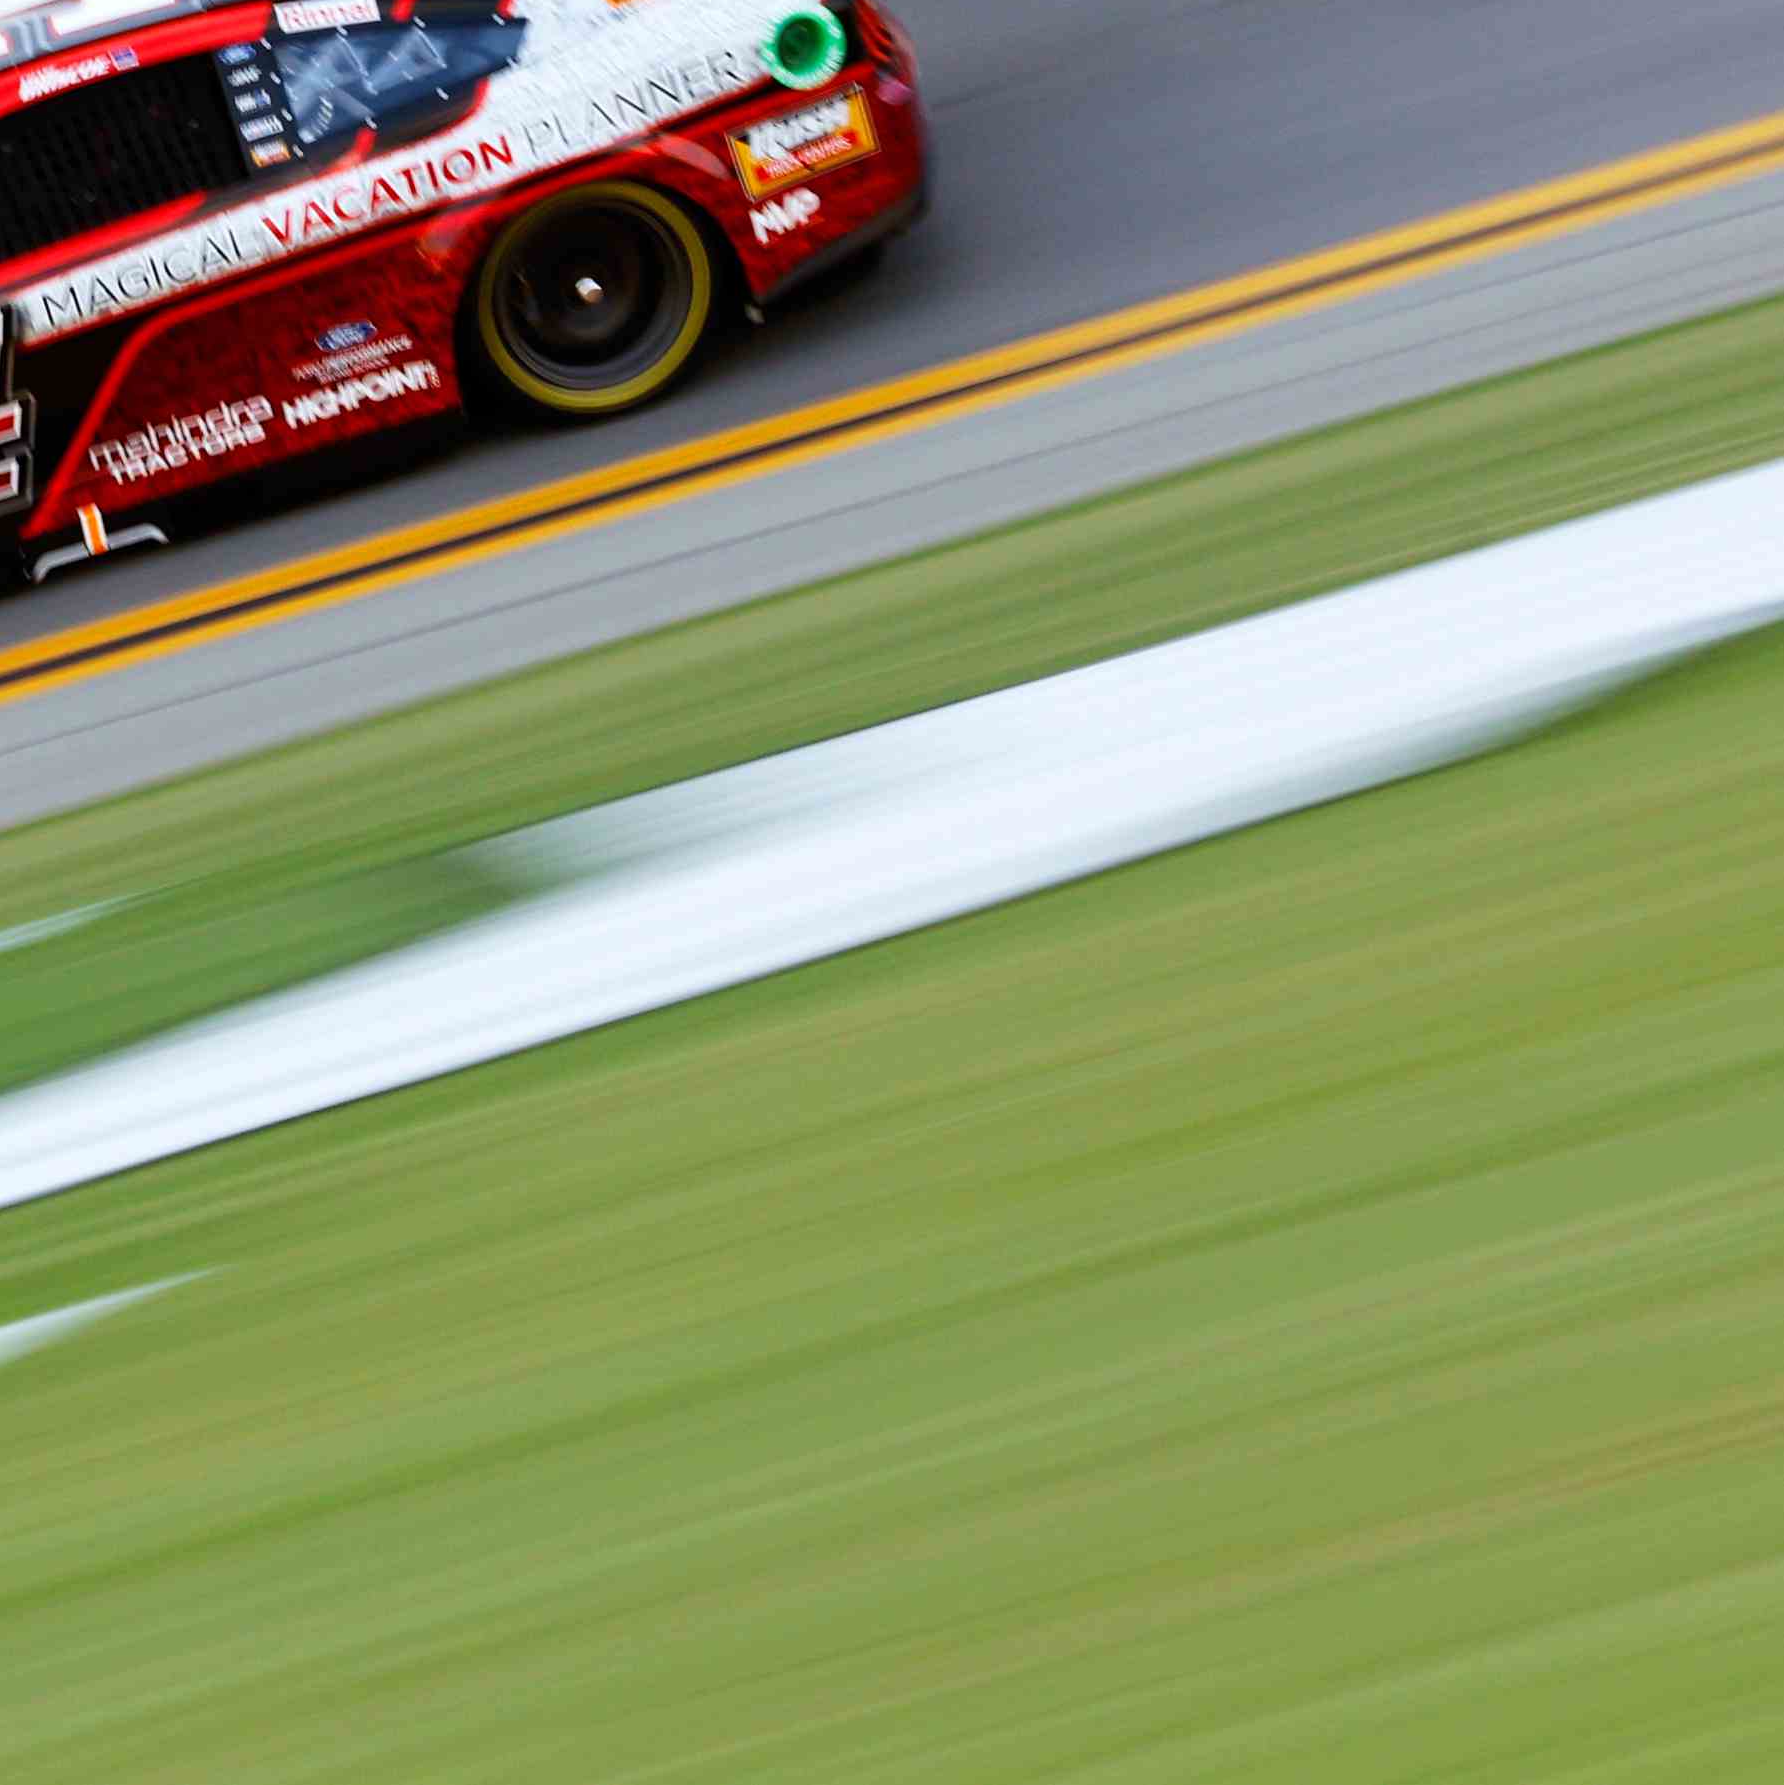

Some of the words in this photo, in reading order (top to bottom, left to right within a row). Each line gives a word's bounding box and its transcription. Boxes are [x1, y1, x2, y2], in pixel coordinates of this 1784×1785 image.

[40, 228, 257, 328] MAGICAL
[262, 135, 514, 247] VACATION
[522, 49, 747, 159] PLANNER
[89, 395, 274, 473] mahindra
[109, 423, 266, 485] TRACTORS
